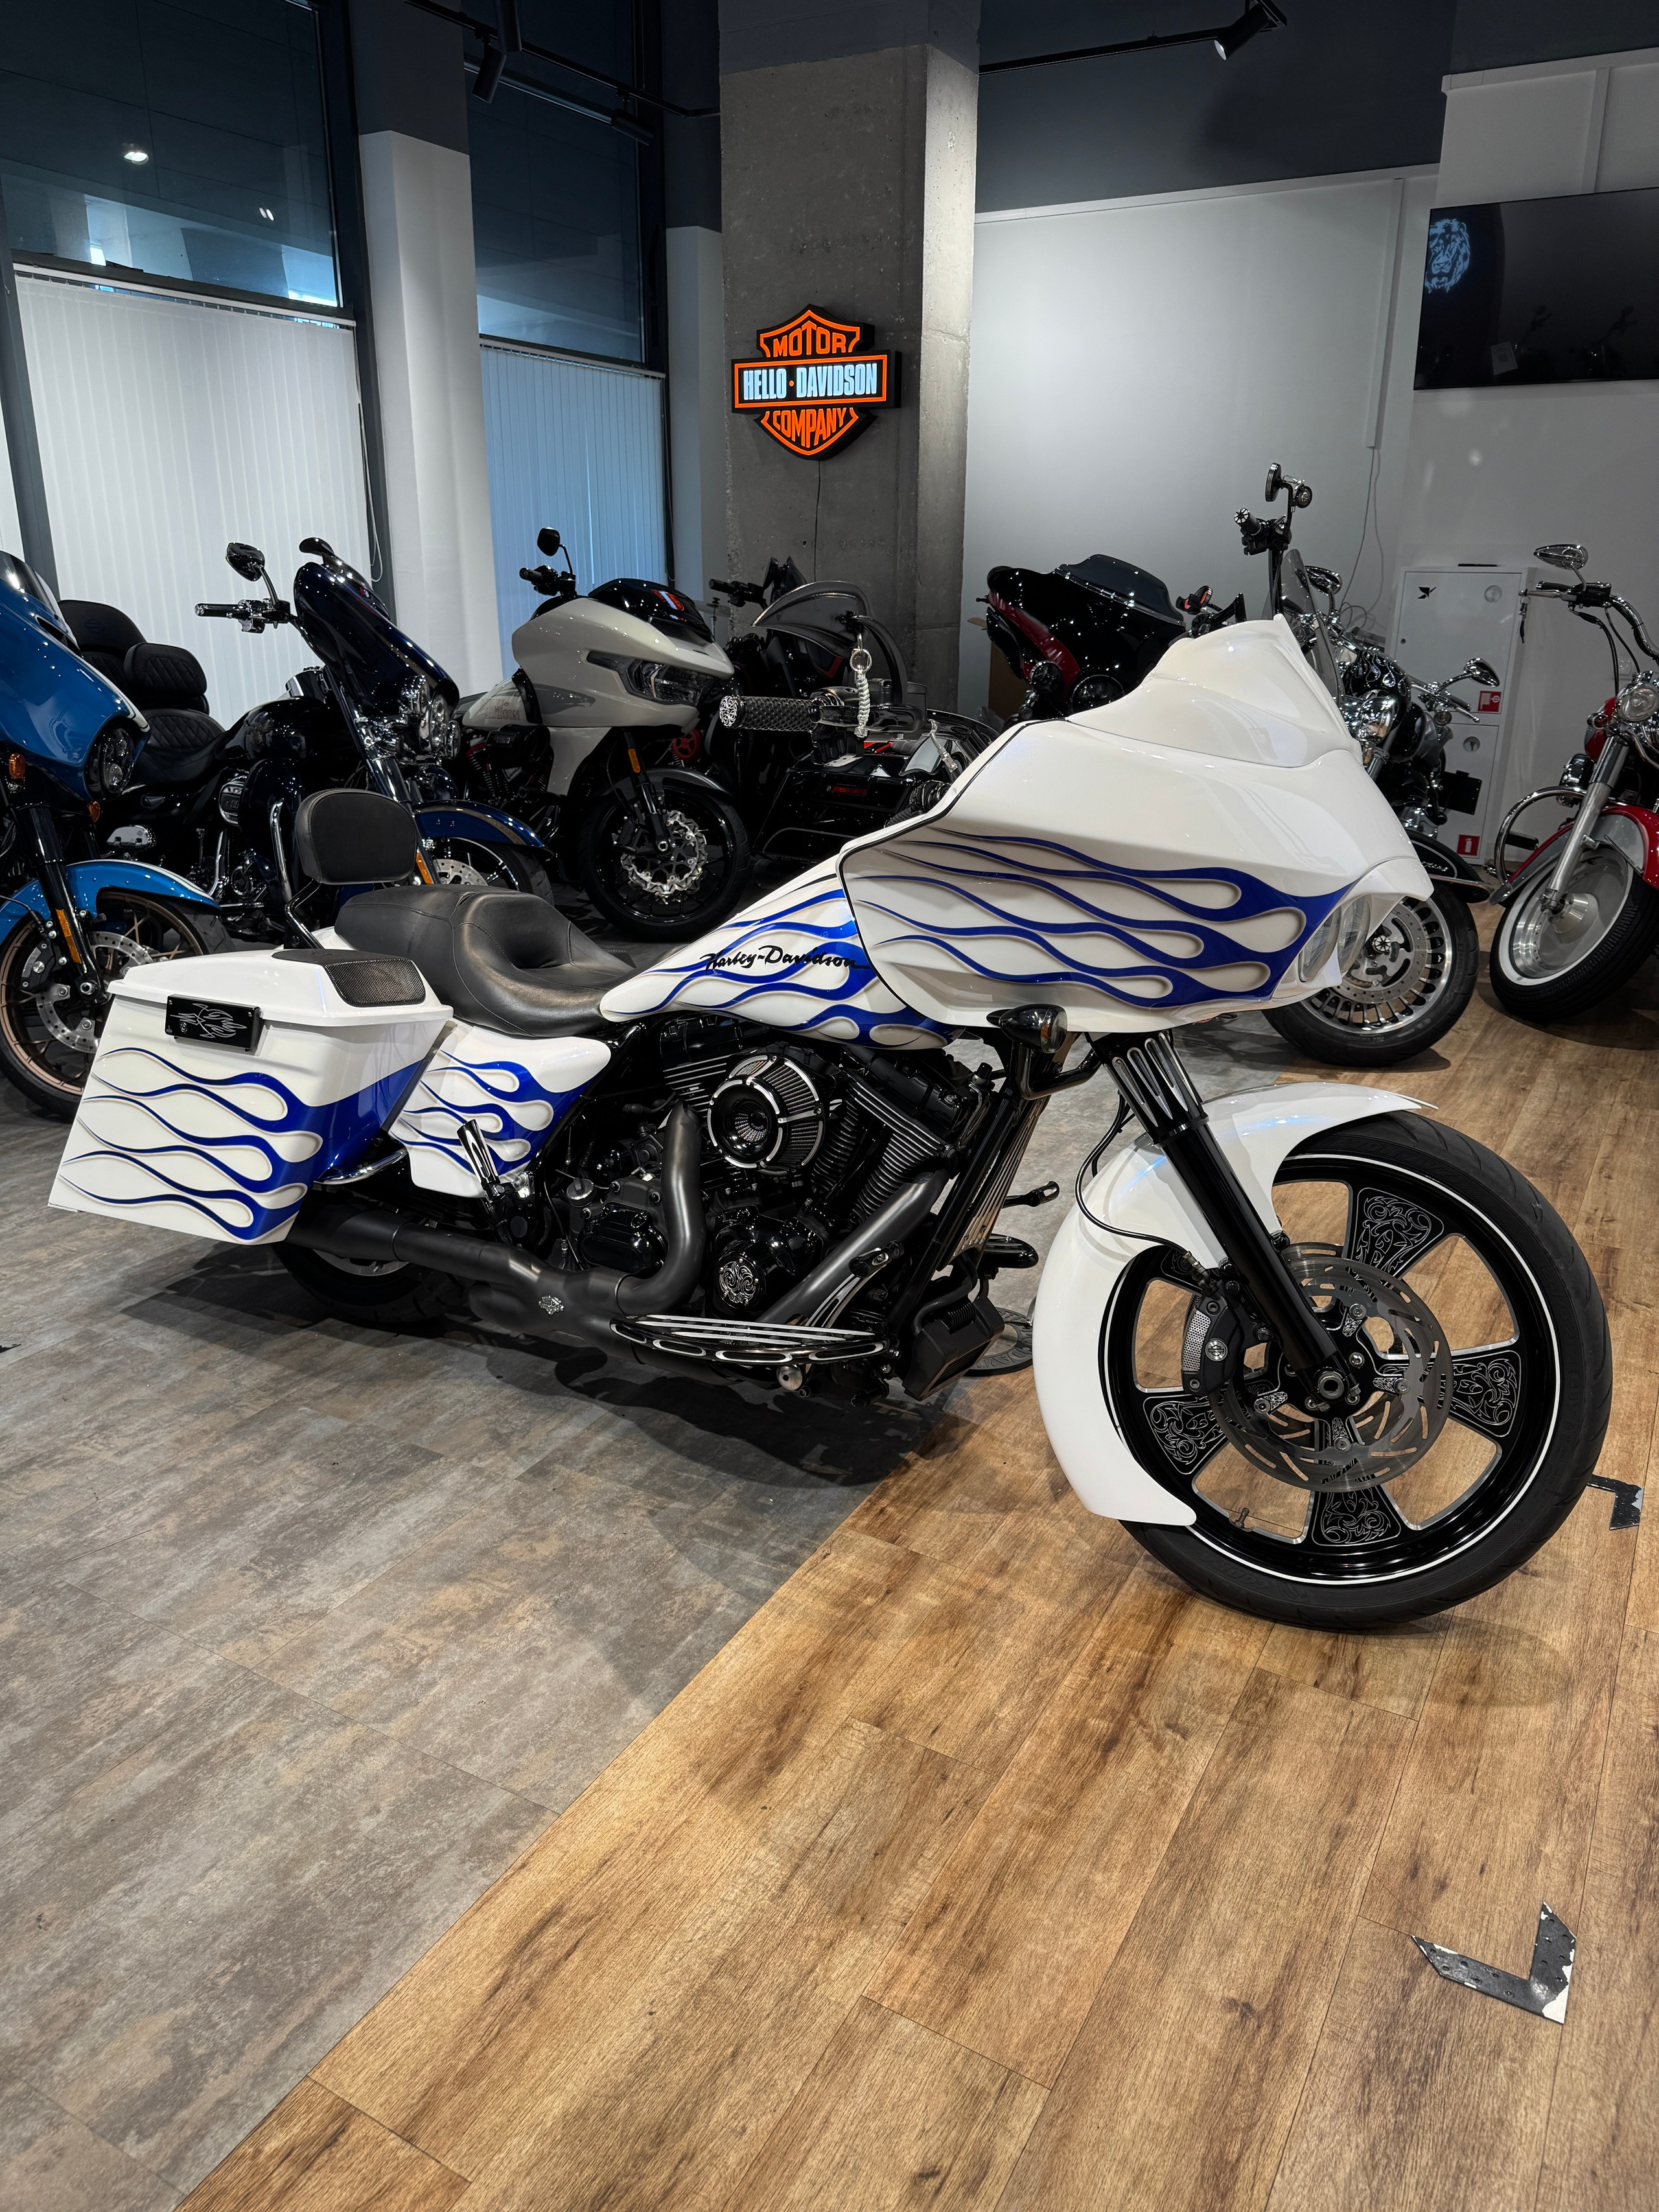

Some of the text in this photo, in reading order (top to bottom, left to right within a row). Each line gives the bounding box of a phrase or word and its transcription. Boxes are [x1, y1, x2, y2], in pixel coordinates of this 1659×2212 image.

[773, 320, 846, 357] MOTOR
[743, 363, 877, 401] HELLO DAVIDSON
[772, 407, 847, 448] COMPANY
[699, 944, 871, 975] Harley-Davidson
